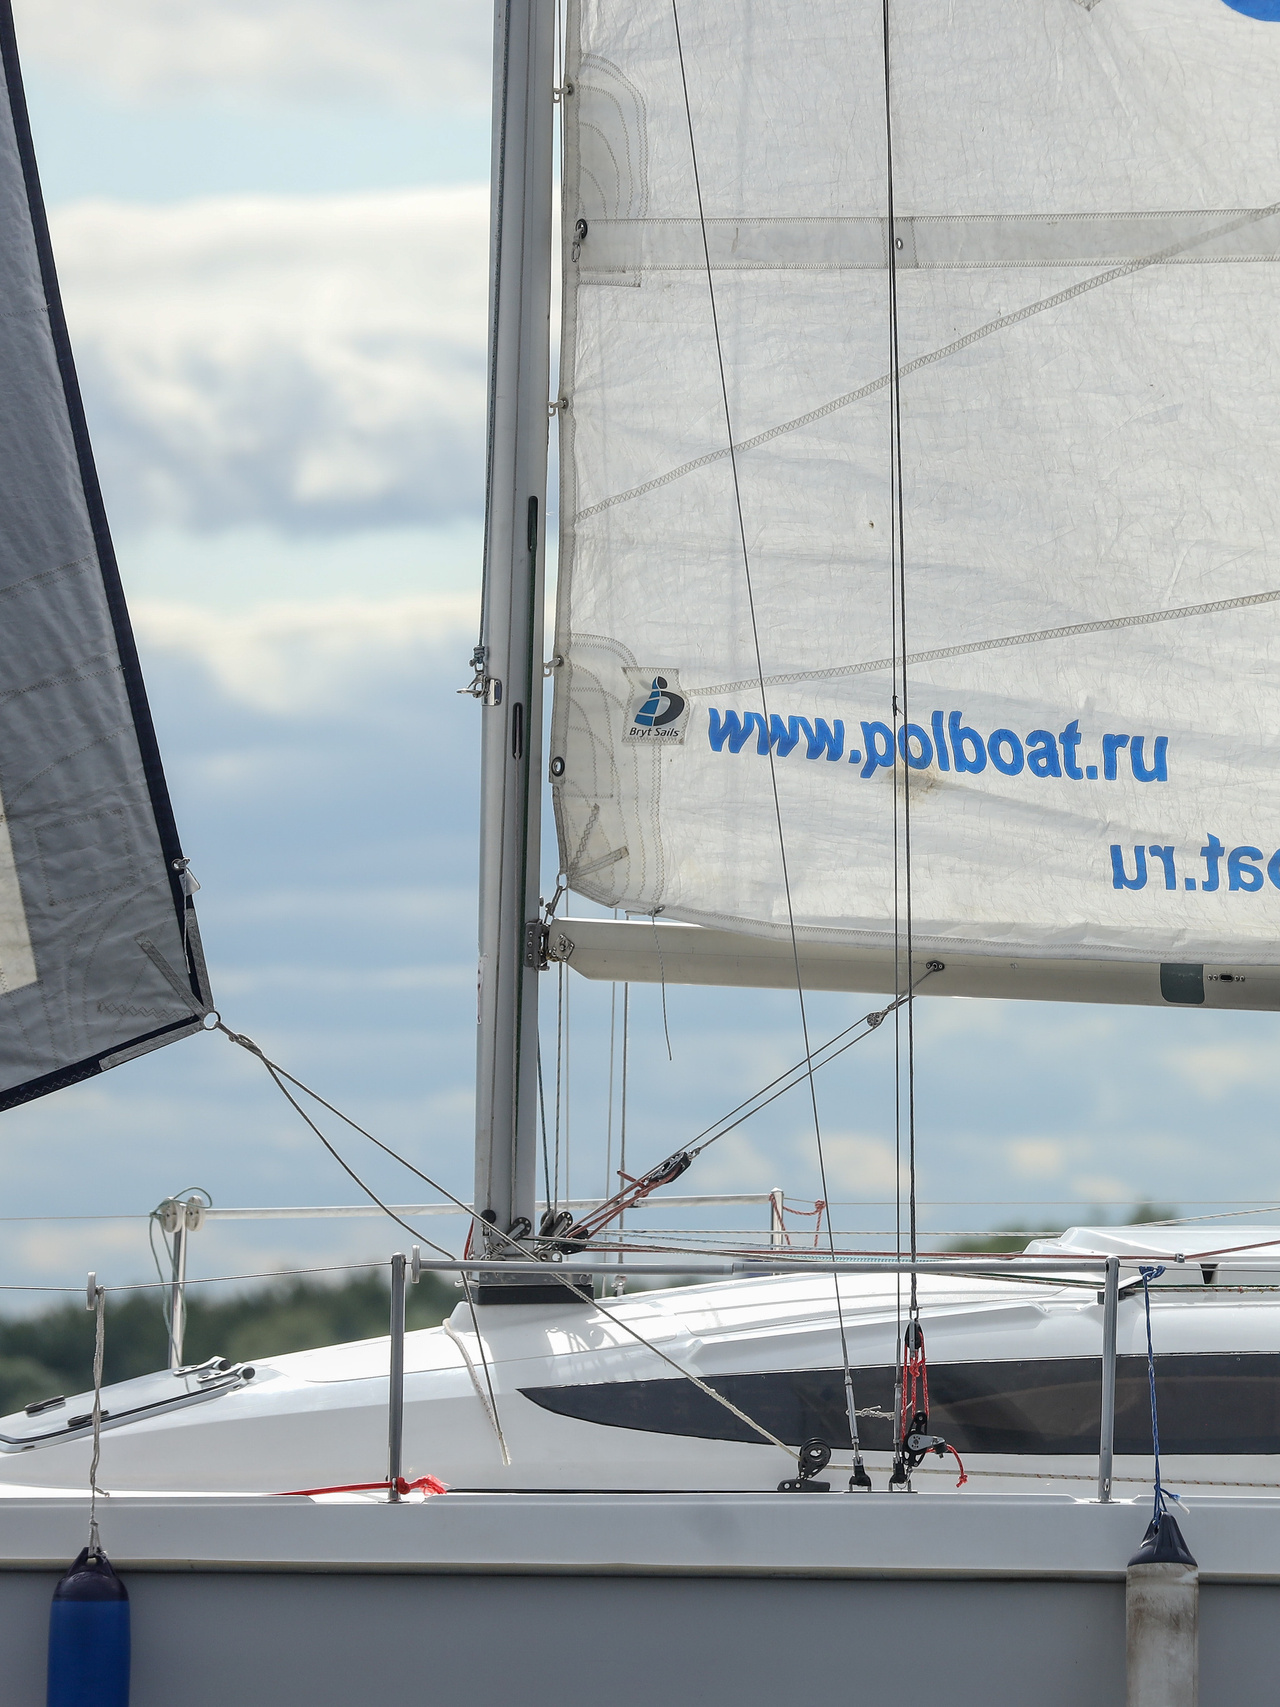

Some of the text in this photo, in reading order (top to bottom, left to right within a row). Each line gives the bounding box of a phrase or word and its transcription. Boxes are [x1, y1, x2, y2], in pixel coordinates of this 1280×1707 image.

[629, 727, 680, 738] Bryt Sails
[708, 707, 1170, 783] www.polboat.ru
